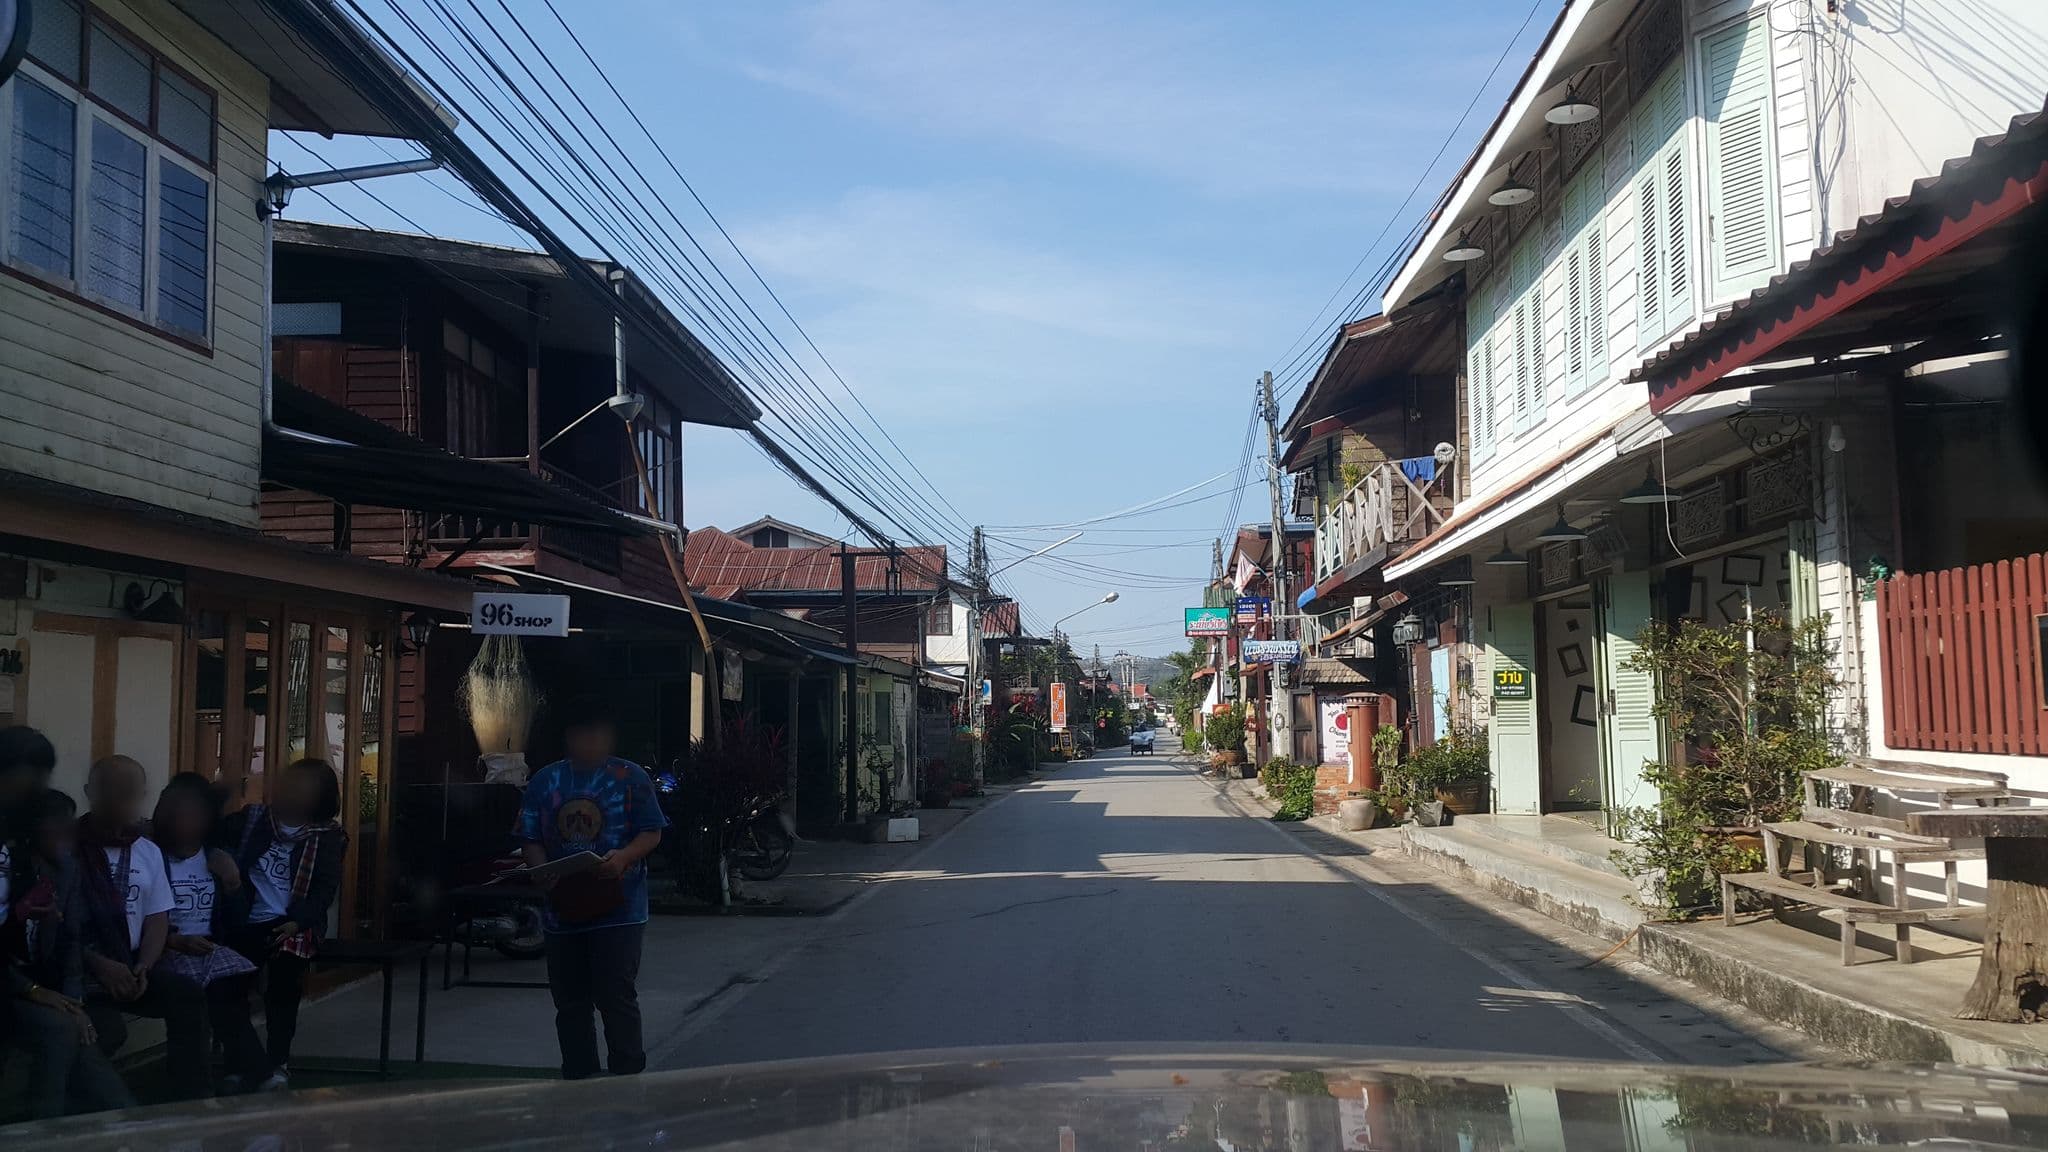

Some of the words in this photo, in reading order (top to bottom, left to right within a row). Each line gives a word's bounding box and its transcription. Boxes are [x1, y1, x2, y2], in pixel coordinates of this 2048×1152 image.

[480, 603, 514, 626] 96
[514, 617, 552, 627] SHOP
[1497, 670, 1522, 684] ว่าง
